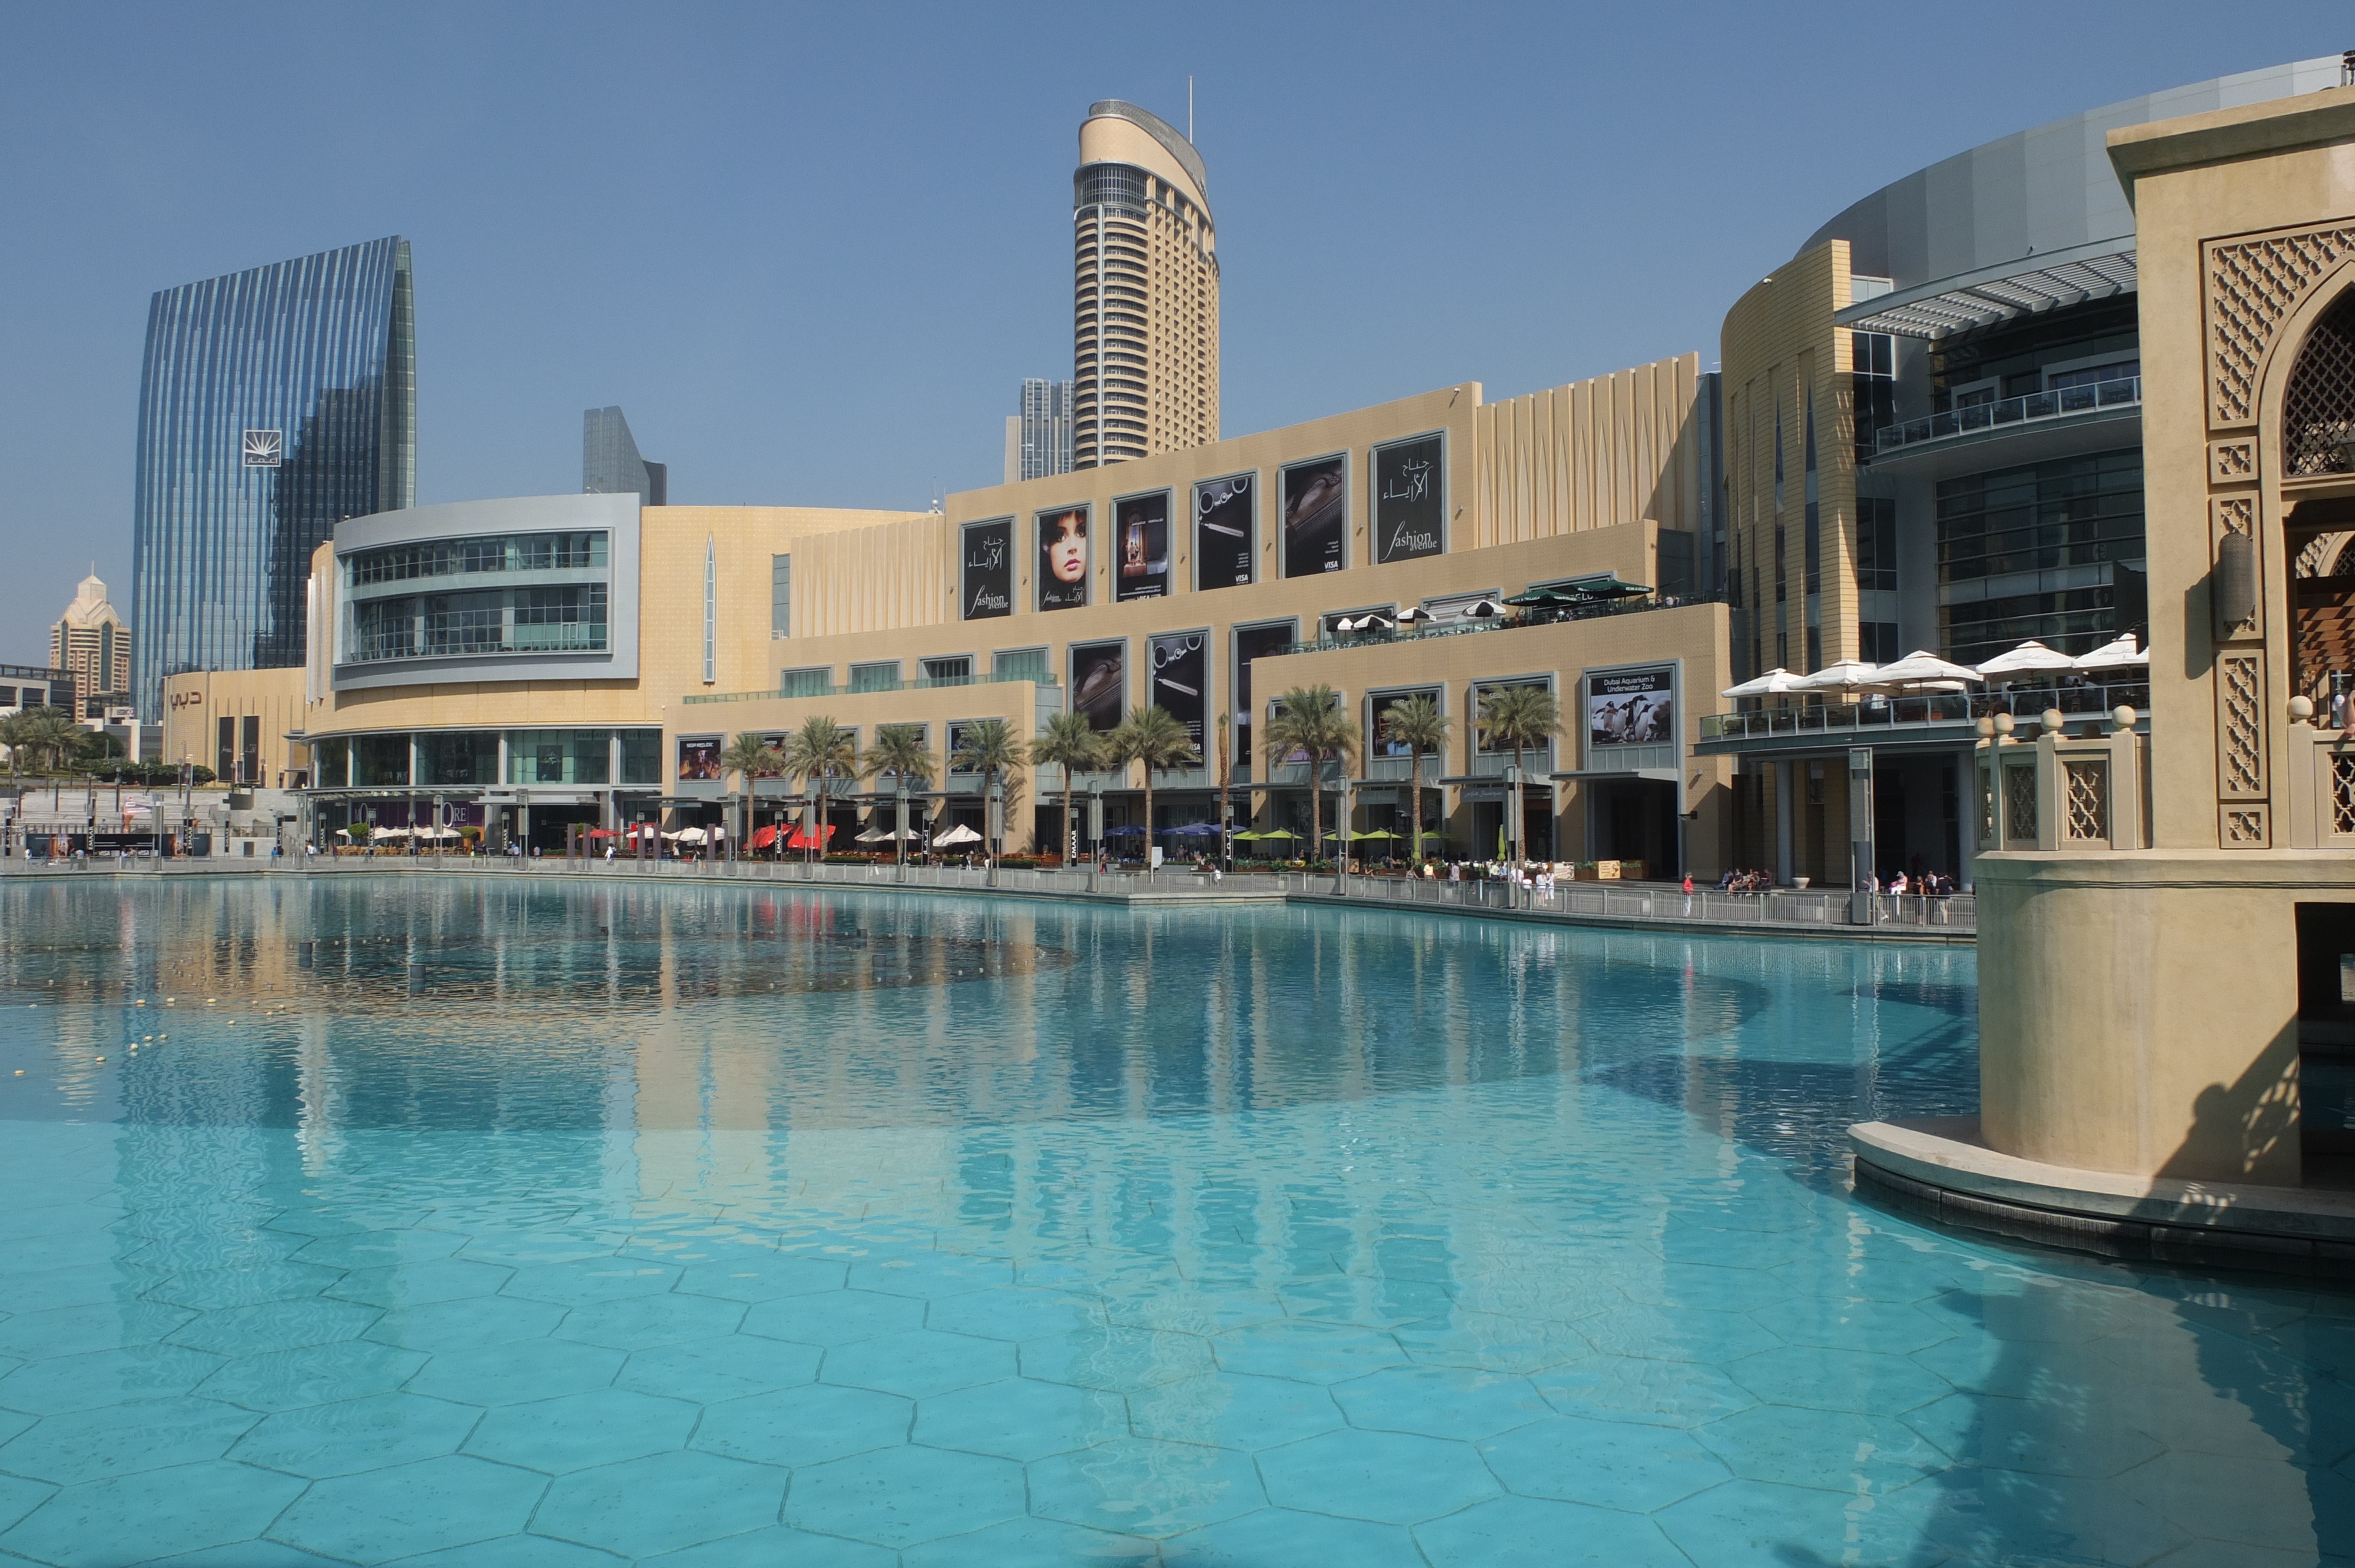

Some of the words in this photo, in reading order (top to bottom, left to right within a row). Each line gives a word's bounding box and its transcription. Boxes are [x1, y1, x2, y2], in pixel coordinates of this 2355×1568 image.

[1402, 458, 1429, 477] جناح
[983, 535, 1004, 550] جناح
[1381, 520, 1431, 561] fashion
[1409, 540, 1437, 552] avenue
[1324, 560, 1339, 569] VISA
[1235, 574, 1249, 582] VISA
[966, 584, 1004, 617] fashion
[988, 601, 1009, 610] avenue
[1604, 677, 1620, 686] Dubai
[1621, 676, 1649, 686] Aquarium
[1607, 685, 1640, 693] Underwater
[170, 691, 202, 712] دبي
